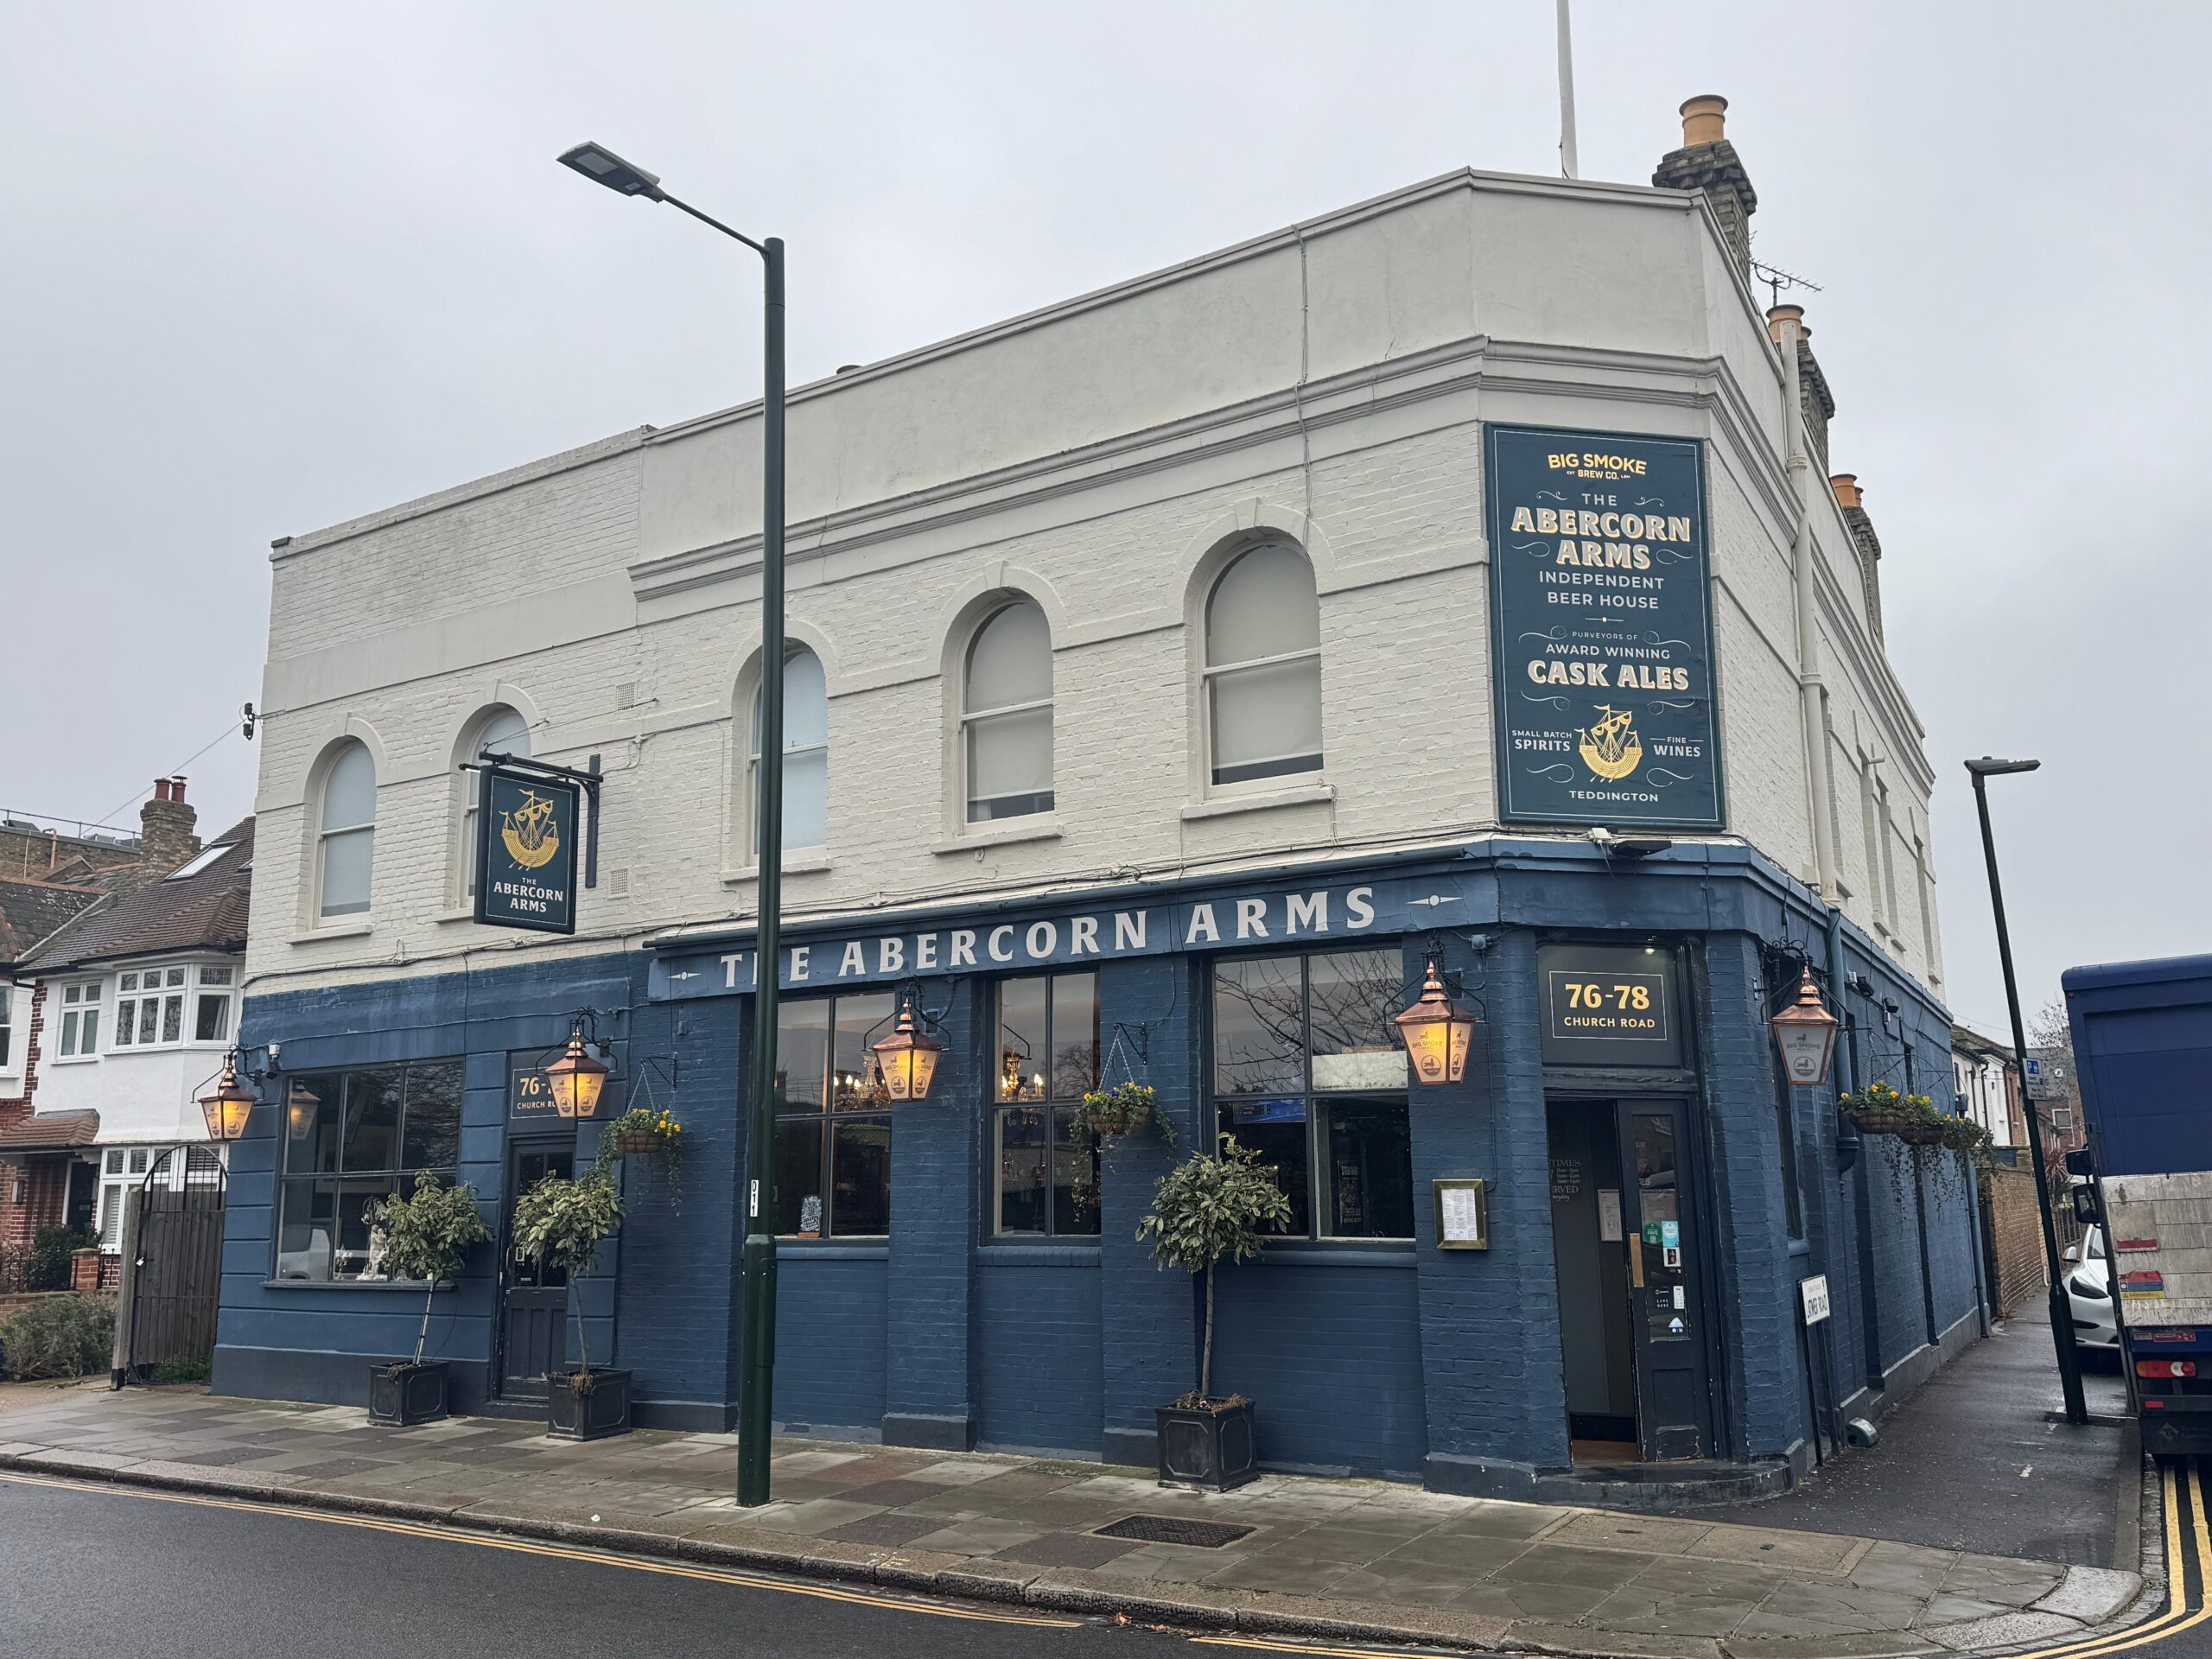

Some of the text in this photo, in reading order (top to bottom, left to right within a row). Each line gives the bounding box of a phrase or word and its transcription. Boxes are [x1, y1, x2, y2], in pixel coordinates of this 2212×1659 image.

[1548, 453, 1647, 475] BIG SMOKE
[1578, 469, 1604, 479] BREW
[1605, 471, 1619, 480] CO.
[1582, 493, 1618, 505] THE
[1511, 506, 1691, 542] ABERCORN
[1555, 539, 1651, 569] ARMS
[1540, 571, 1664, 589] INDEPENDENT
[1548, 592, 1659, 608] BEER HOUSE
[1573, 631, 1624, 640] PURVEYORS
[1546, 644, 1670, 659] AWARD WINNING
[1528, 659, 1689, 690] CASK ALES
[1512, 729, 1541, 738] SMALL
[1515, 739, 1571, 752] SPIRITS
[1653, 745, 1701, 757] WINES
[1569, 790, 1658, 802] TEDDINGTON
[493, 881, 563, 902] ABERCORN
[510, 898, 547, 912] ARMS
[721, 887, 1375, 988] TE ABERCORN ARMS
[1565, 983, 1649, 1010] 76-78
[1564, 1016, 1656, 1028] CHURCH ROAD
[520, 1077, 551, 1096] 76-
[517, 1101, 545, 1109] CHURCH
[1552, 1185, 1579, 1193] RVED
